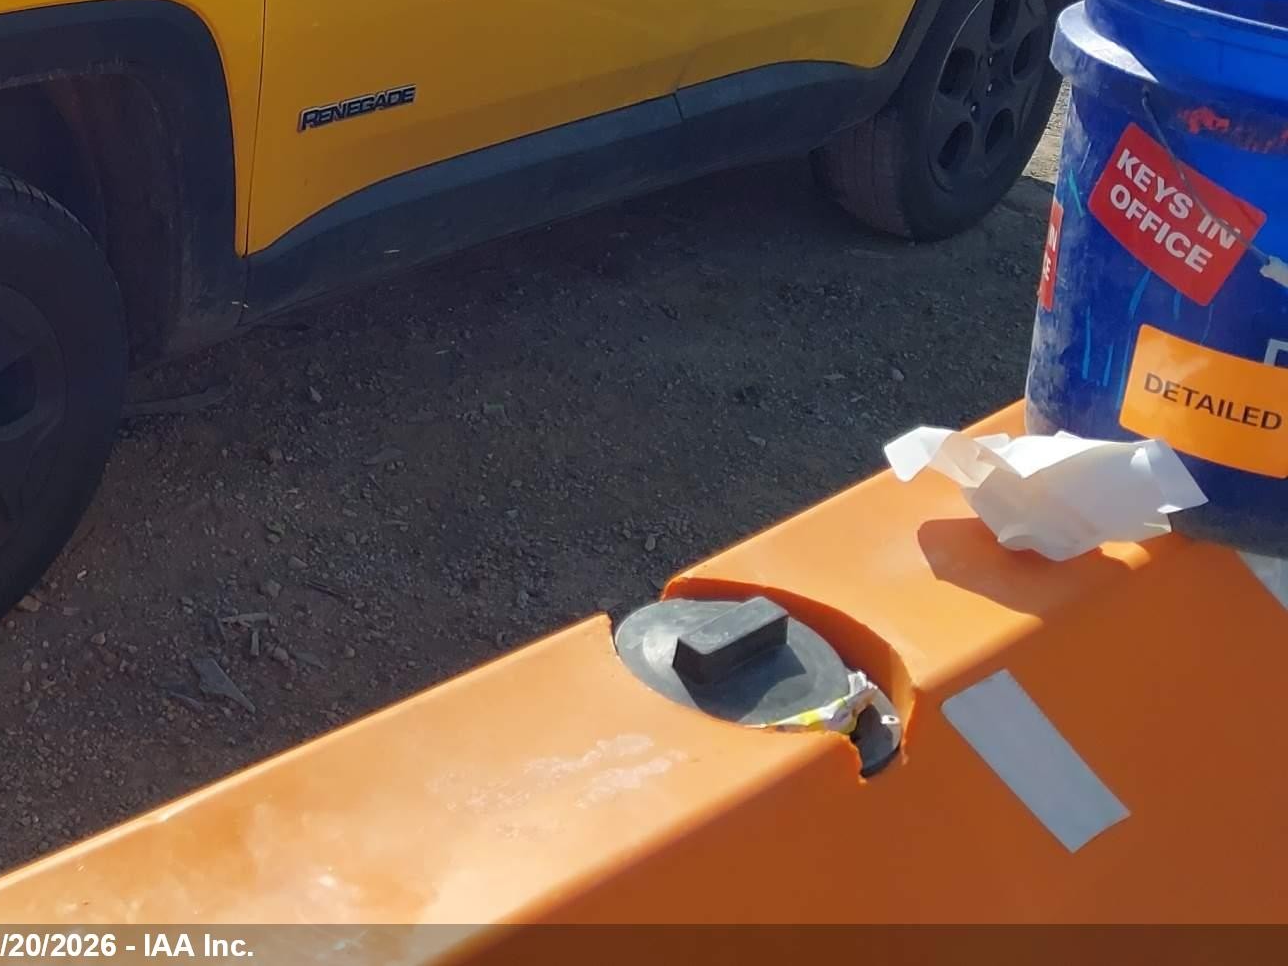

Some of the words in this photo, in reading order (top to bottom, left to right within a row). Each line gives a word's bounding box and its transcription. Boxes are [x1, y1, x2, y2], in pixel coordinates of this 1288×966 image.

[297, 84, 417, 133] RENEGADE
[1110, 183, 1213, 274] OFFICE
[1116, 148, 1194, 219] KEYS
[1196, 213, 1241, 250] IN
[1144, 372, 1283, 431] DETAILED
